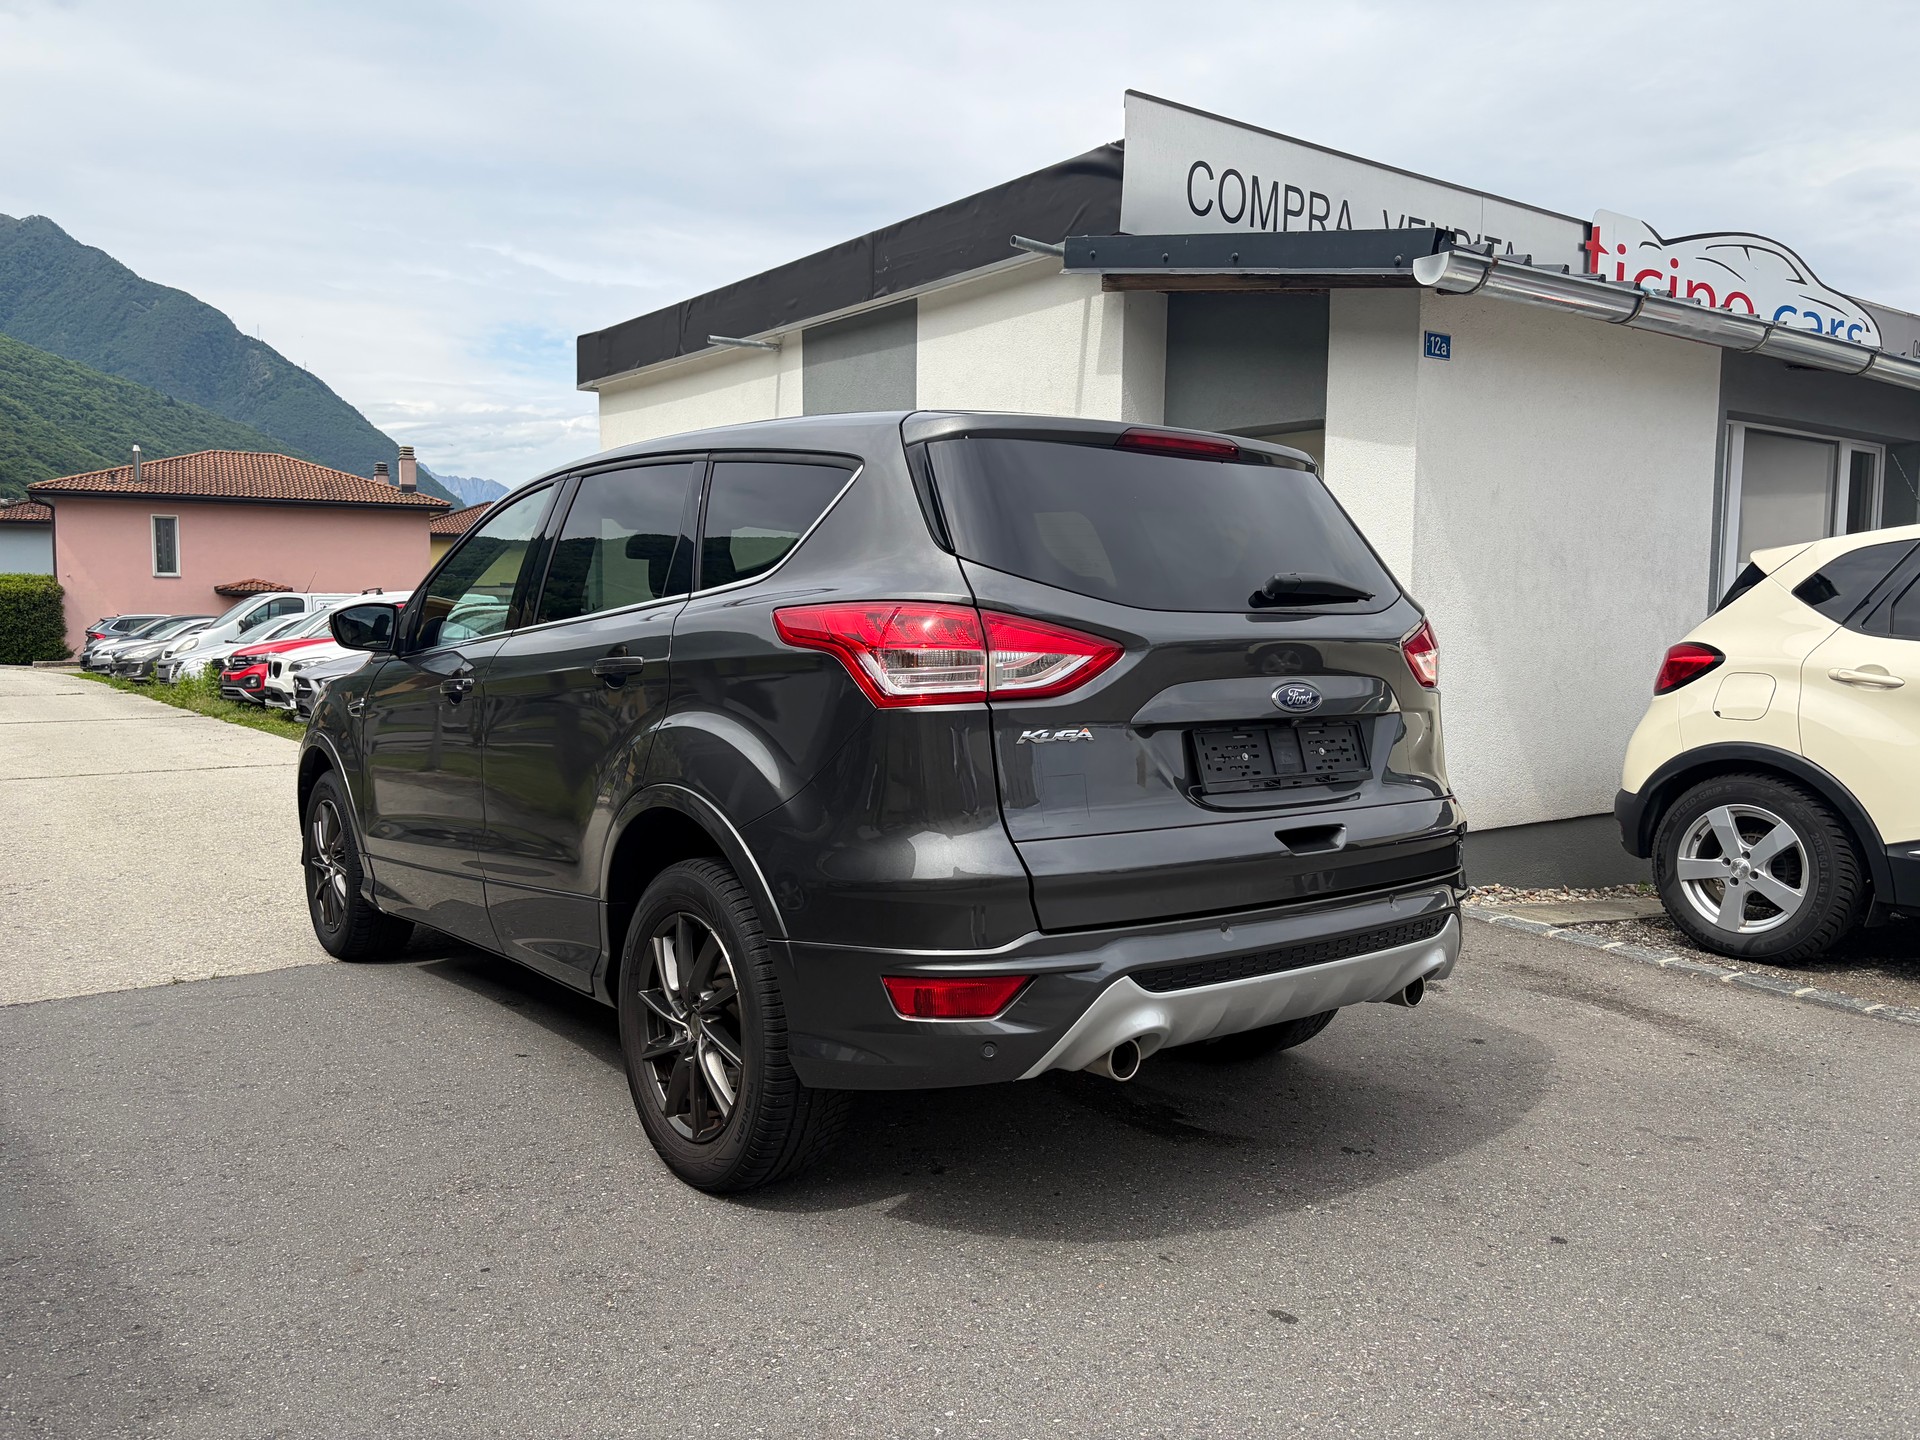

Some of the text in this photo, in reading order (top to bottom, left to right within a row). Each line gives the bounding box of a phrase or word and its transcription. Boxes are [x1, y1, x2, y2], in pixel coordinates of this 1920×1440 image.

[1186, 160, 1353, 232] COMPRA
[1430, 336, 1447, 355] 12a
[1286, 688, 1313, 705] Ford
[1016, 727, 1095, 745] KUGA
[1810, 832, 1829, 868] 205/60
